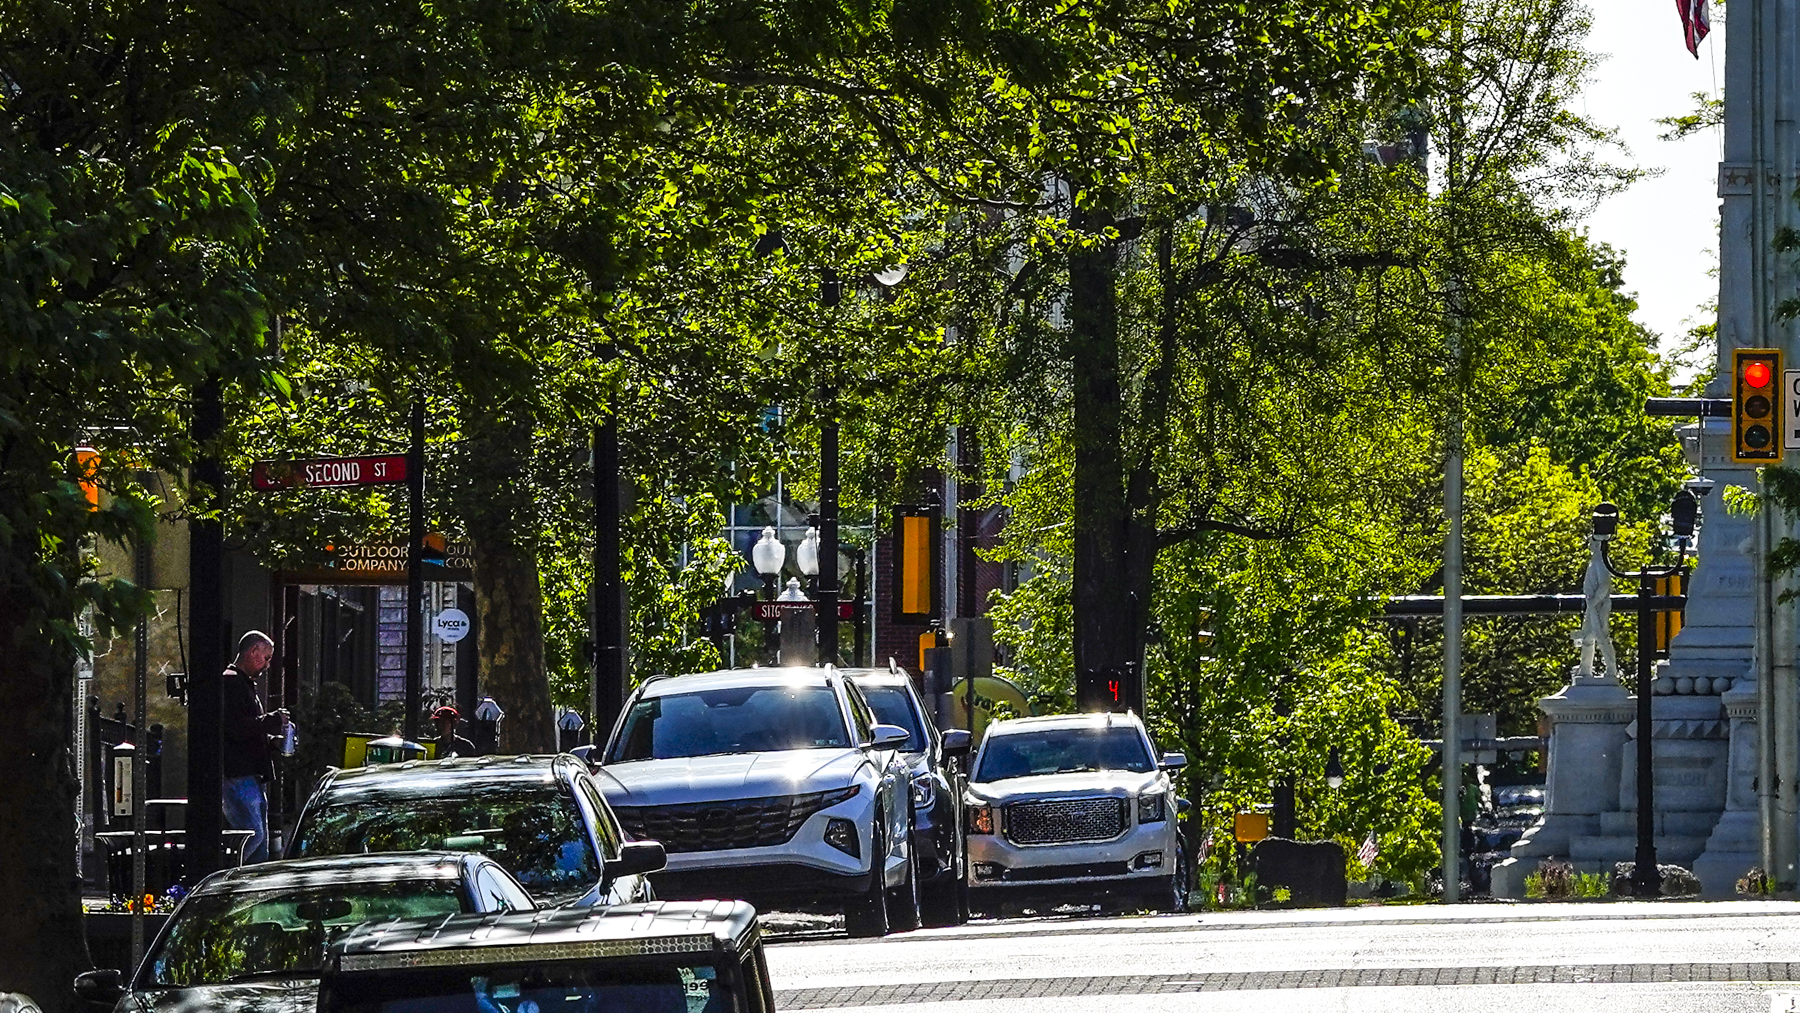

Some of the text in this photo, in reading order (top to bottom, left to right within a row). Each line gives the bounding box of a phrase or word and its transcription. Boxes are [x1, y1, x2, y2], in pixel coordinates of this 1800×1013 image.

[306, 462, 387, 483] SECOND ST
[438, 618, 460, 629] Lyca
[1109, 680, 1118, 701] 4
